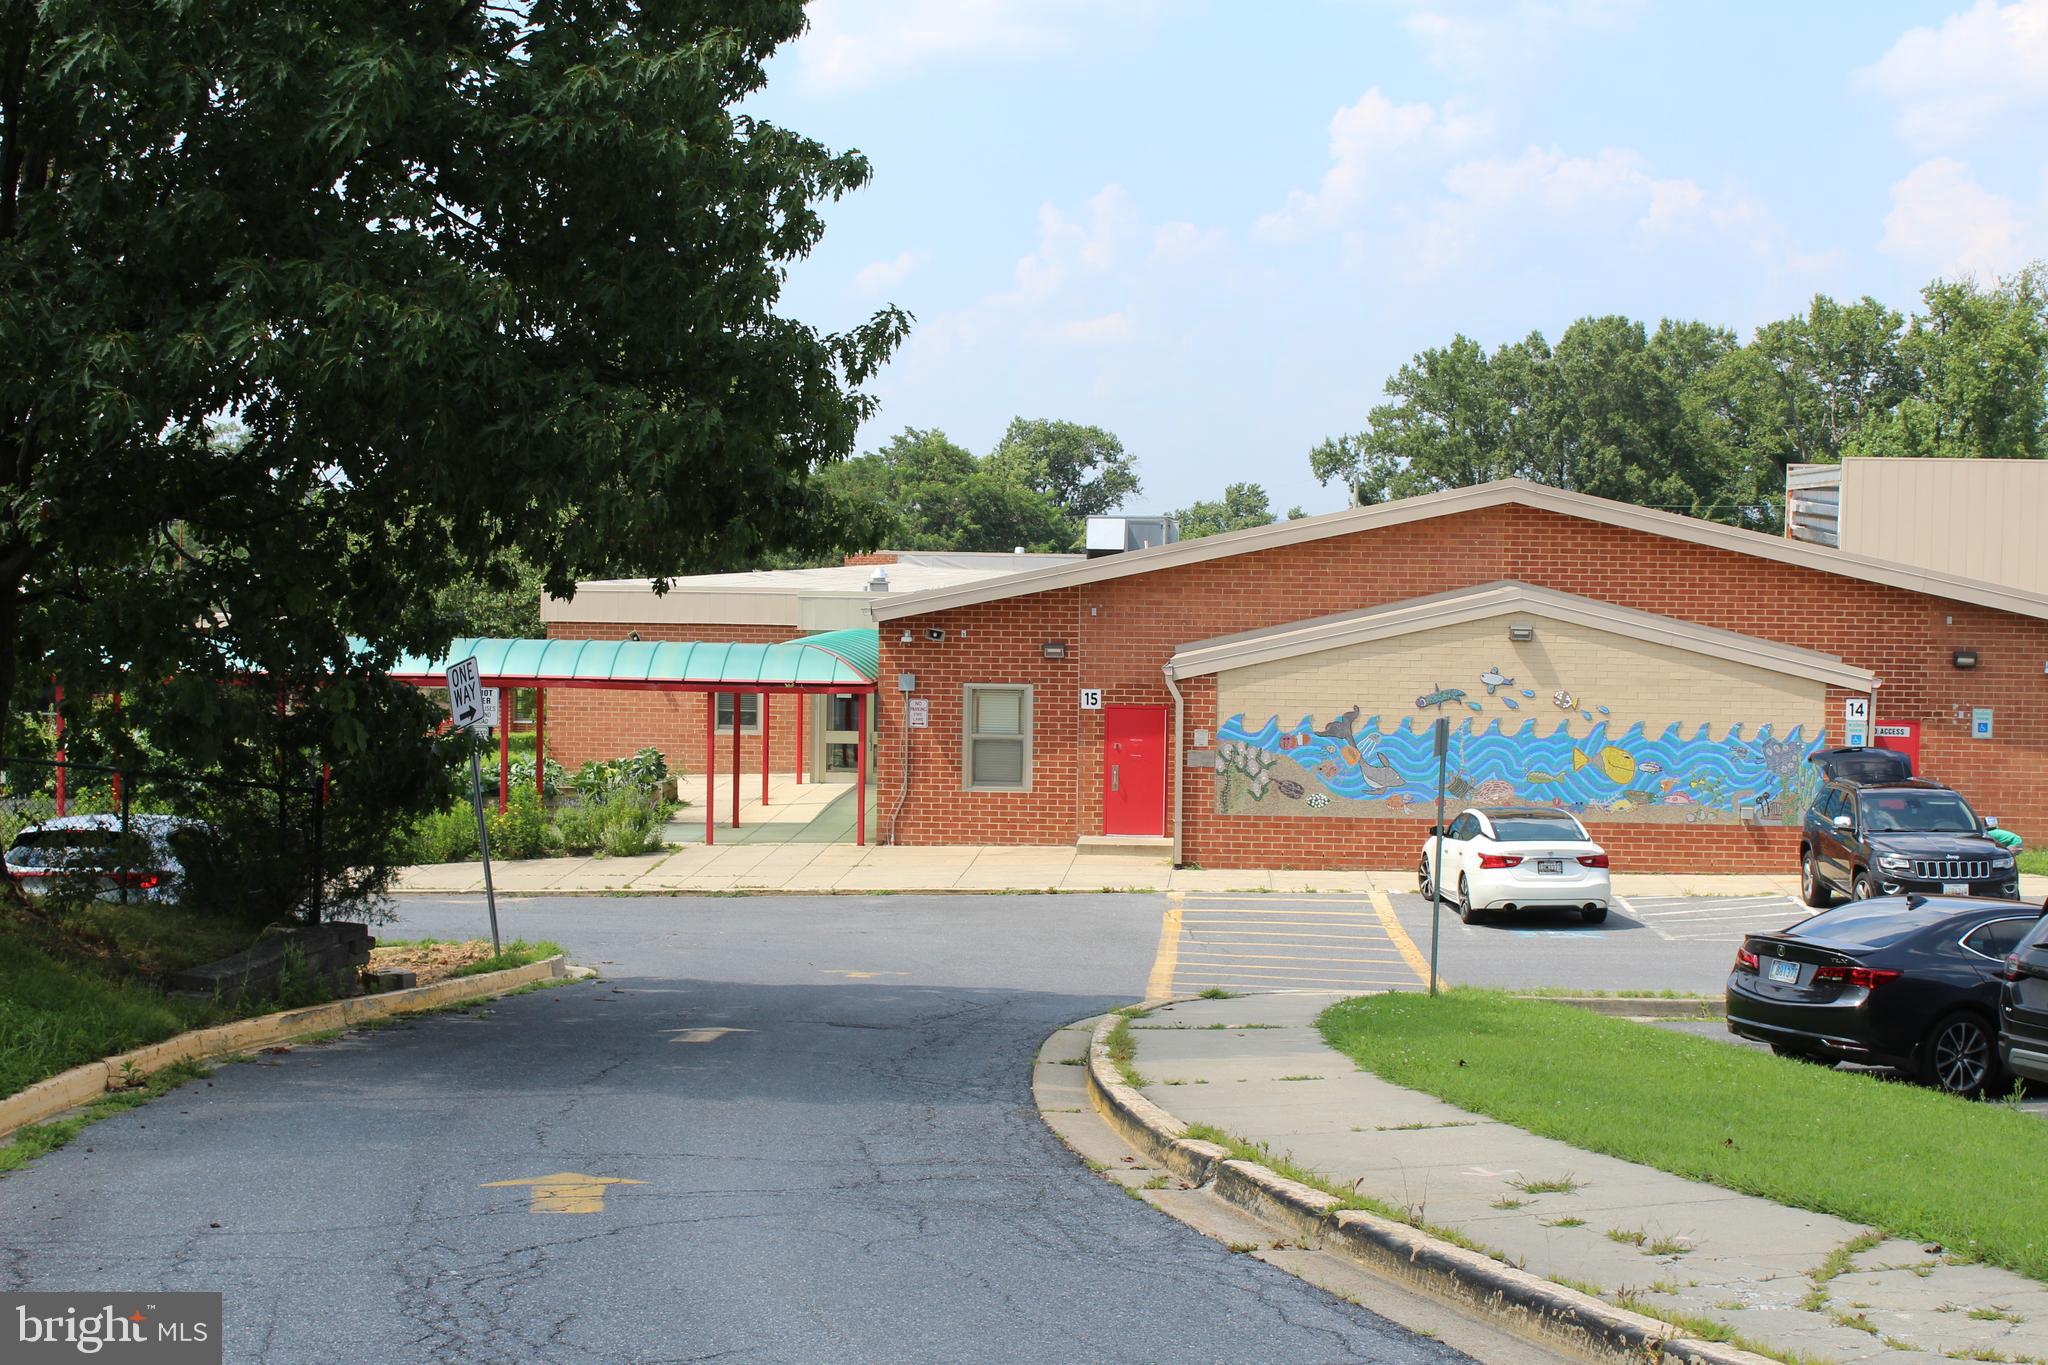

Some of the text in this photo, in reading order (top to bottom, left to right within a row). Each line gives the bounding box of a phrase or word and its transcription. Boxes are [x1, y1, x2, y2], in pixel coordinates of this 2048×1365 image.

[452, 662, 474, 687] ONE
[453, 681, 476, 708] WAY
[1084, 692, 1098, 706] 15
[1849, 702, 1864, 717] 14
[1880, 727, 1905, 735] ACCESS
